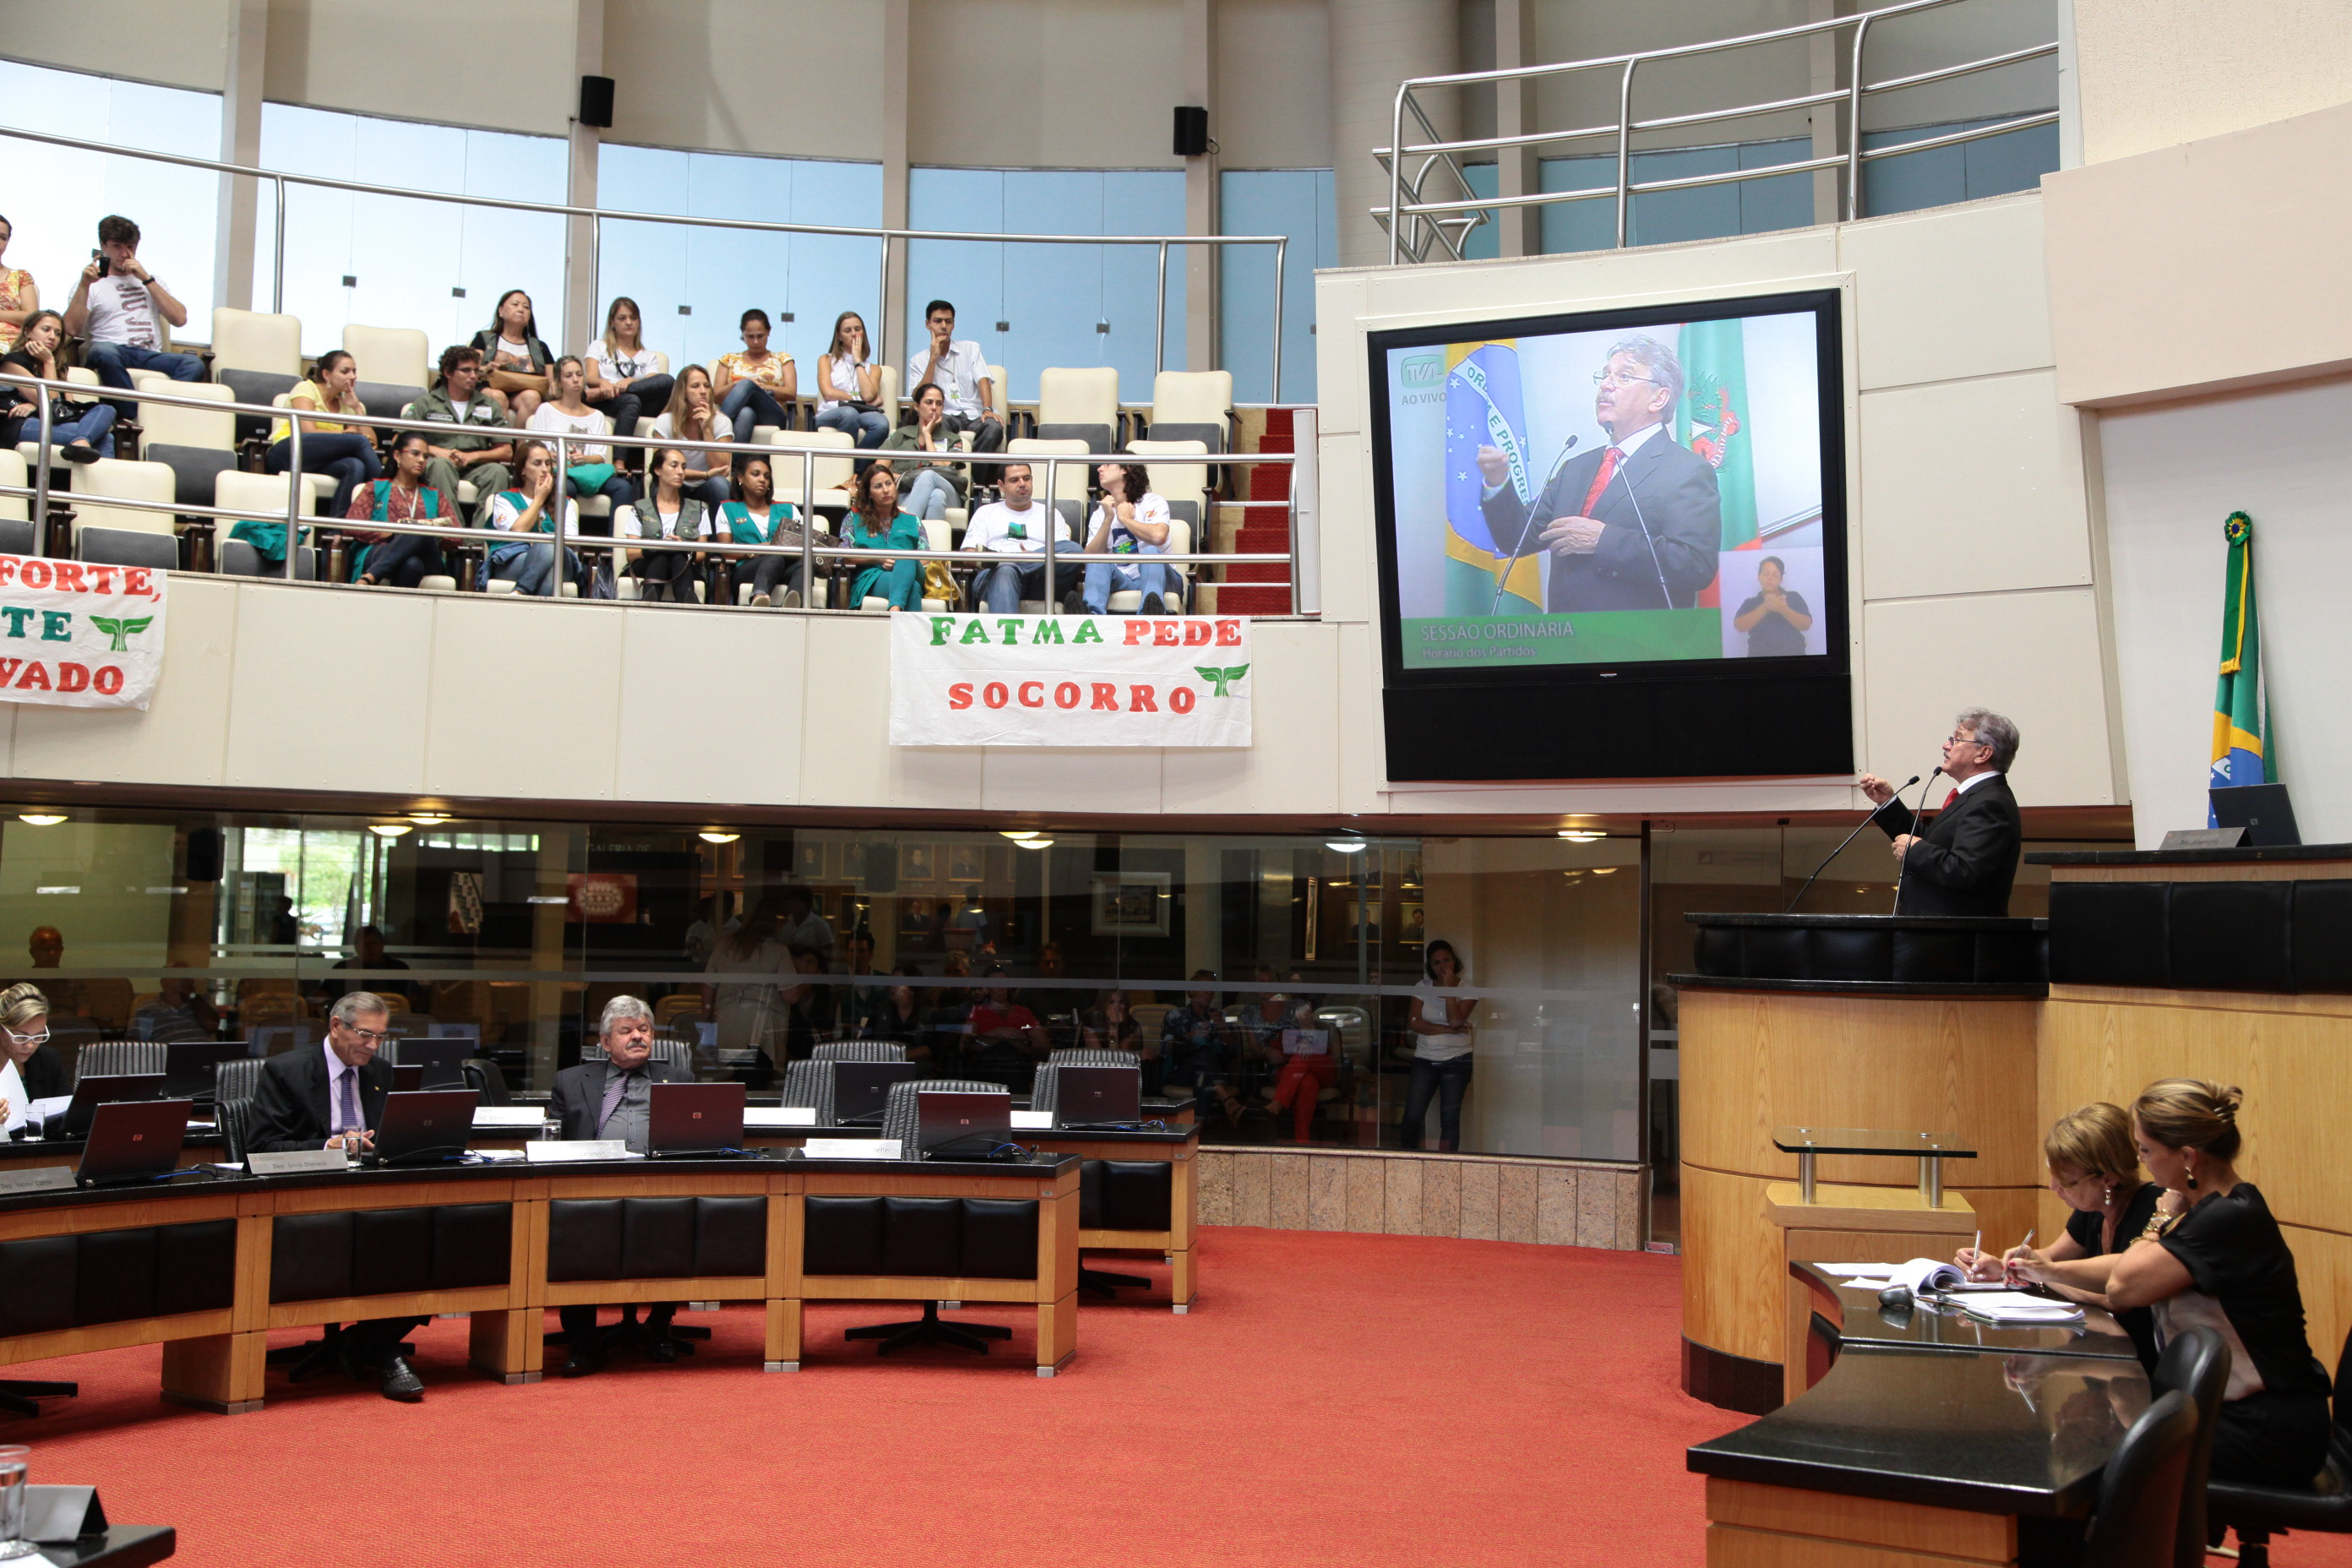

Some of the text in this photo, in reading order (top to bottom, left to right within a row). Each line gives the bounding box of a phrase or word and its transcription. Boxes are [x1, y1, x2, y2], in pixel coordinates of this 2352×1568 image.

[115, 284, 148, 312] JIU
[1402, 392, 1447, 406] AO VIVO
[1489, 415, 1501, 427] E
[0, 555, 161, 602] FORTE,
[930, 617, 1242, 646] FATMA PEDE
[1421, 618, 1574, 641] SESSÃO ORDINÁRIA
[1466, 647, 1487, 658] dos
[1489, 645, 1536, 657] Partidos
[948, 680, 1196, 714] SOCORRO
